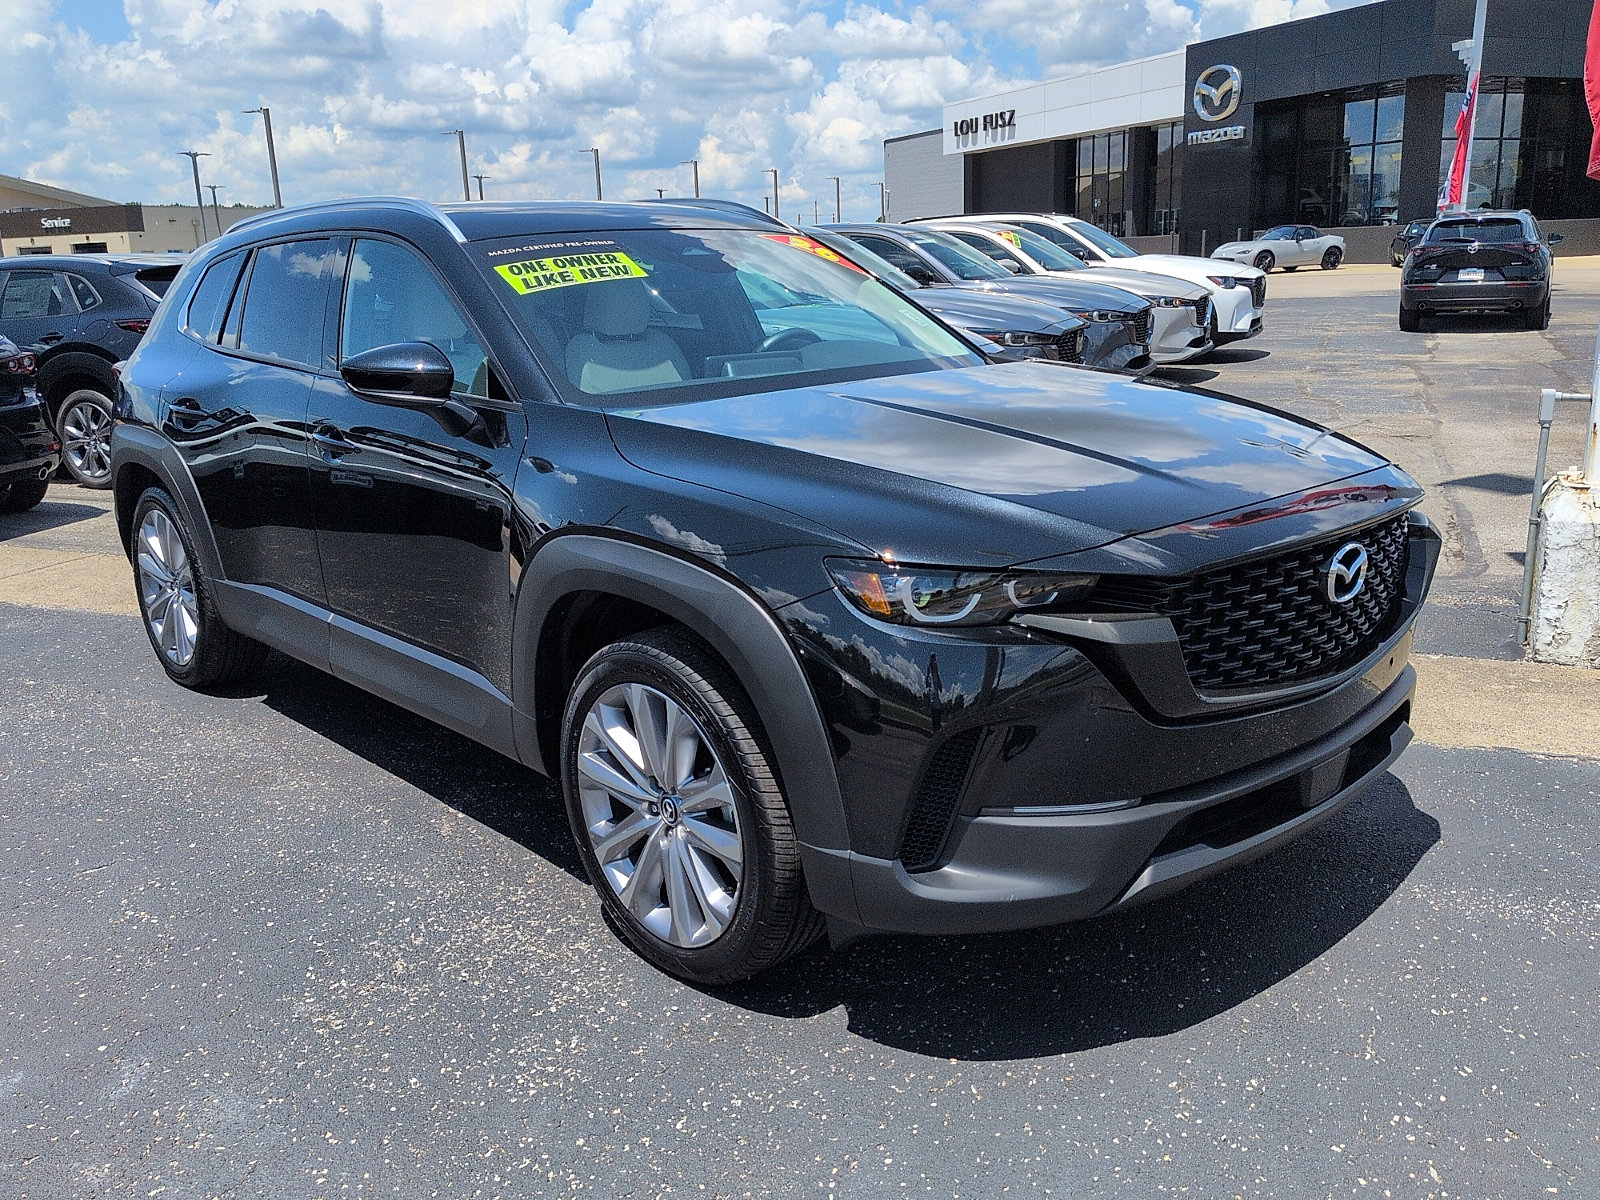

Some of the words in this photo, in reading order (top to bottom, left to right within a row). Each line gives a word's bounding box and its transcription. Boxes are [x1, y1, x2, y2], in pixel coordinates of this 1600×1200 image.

[954, 117, 979, 136] LOU
[983, 109, 1016, 131] FUSZ
[41, 217, 71, 228] Service
[488, 247, 522, 256] MAZDA
[523, 243, 564, 252] CERTIFIED
[507, 260, 549, 276] ONE
[552, 254, 621, 269] OWNER
[521, 271, 573, 289] LIKE
[580, 264, 630, 280] NEW
